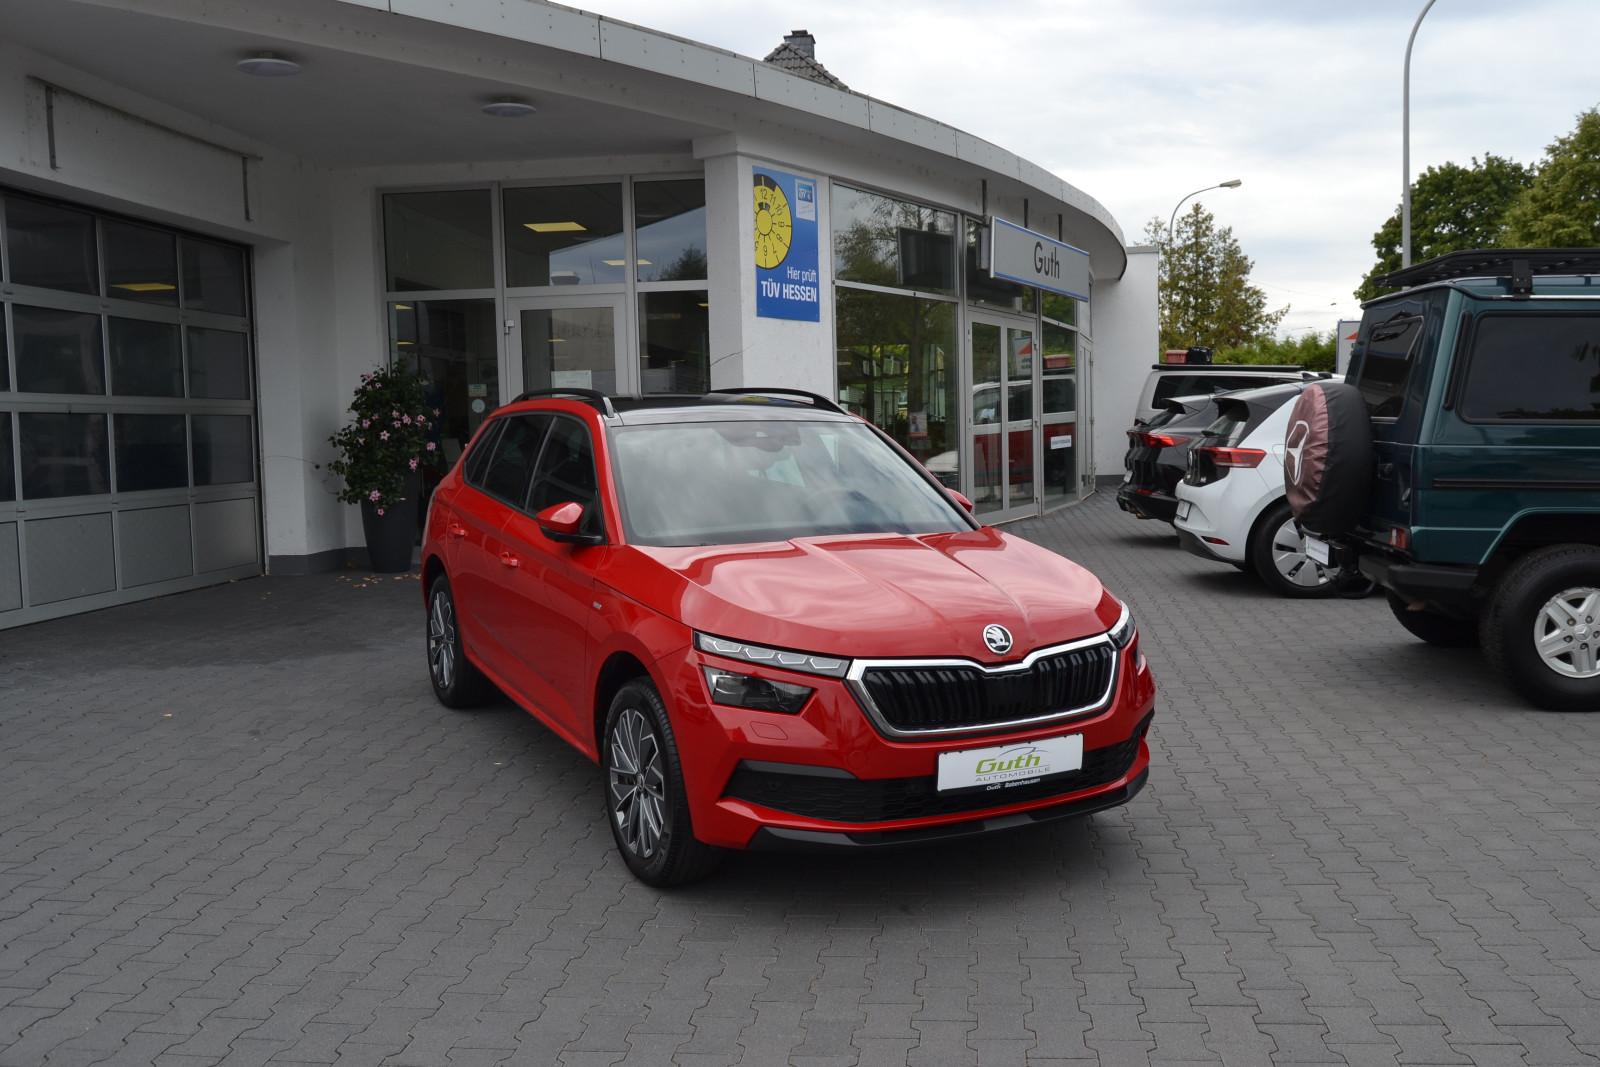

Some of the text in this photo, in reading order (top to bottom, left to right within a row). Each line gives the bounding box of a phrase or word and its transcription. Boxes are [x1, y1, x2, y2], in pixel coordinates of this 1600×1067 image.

[760, 188, 768, 200] 12
[1034, 242, 1060, 280] Guth
[787, 266, 817, 284] Hier prüft
[760, 277, 817, 302] TÜV HESSEN
[975, 754, 1041, 774] Guth
[975, 767, 1050, 781] AUTOMOBILE
